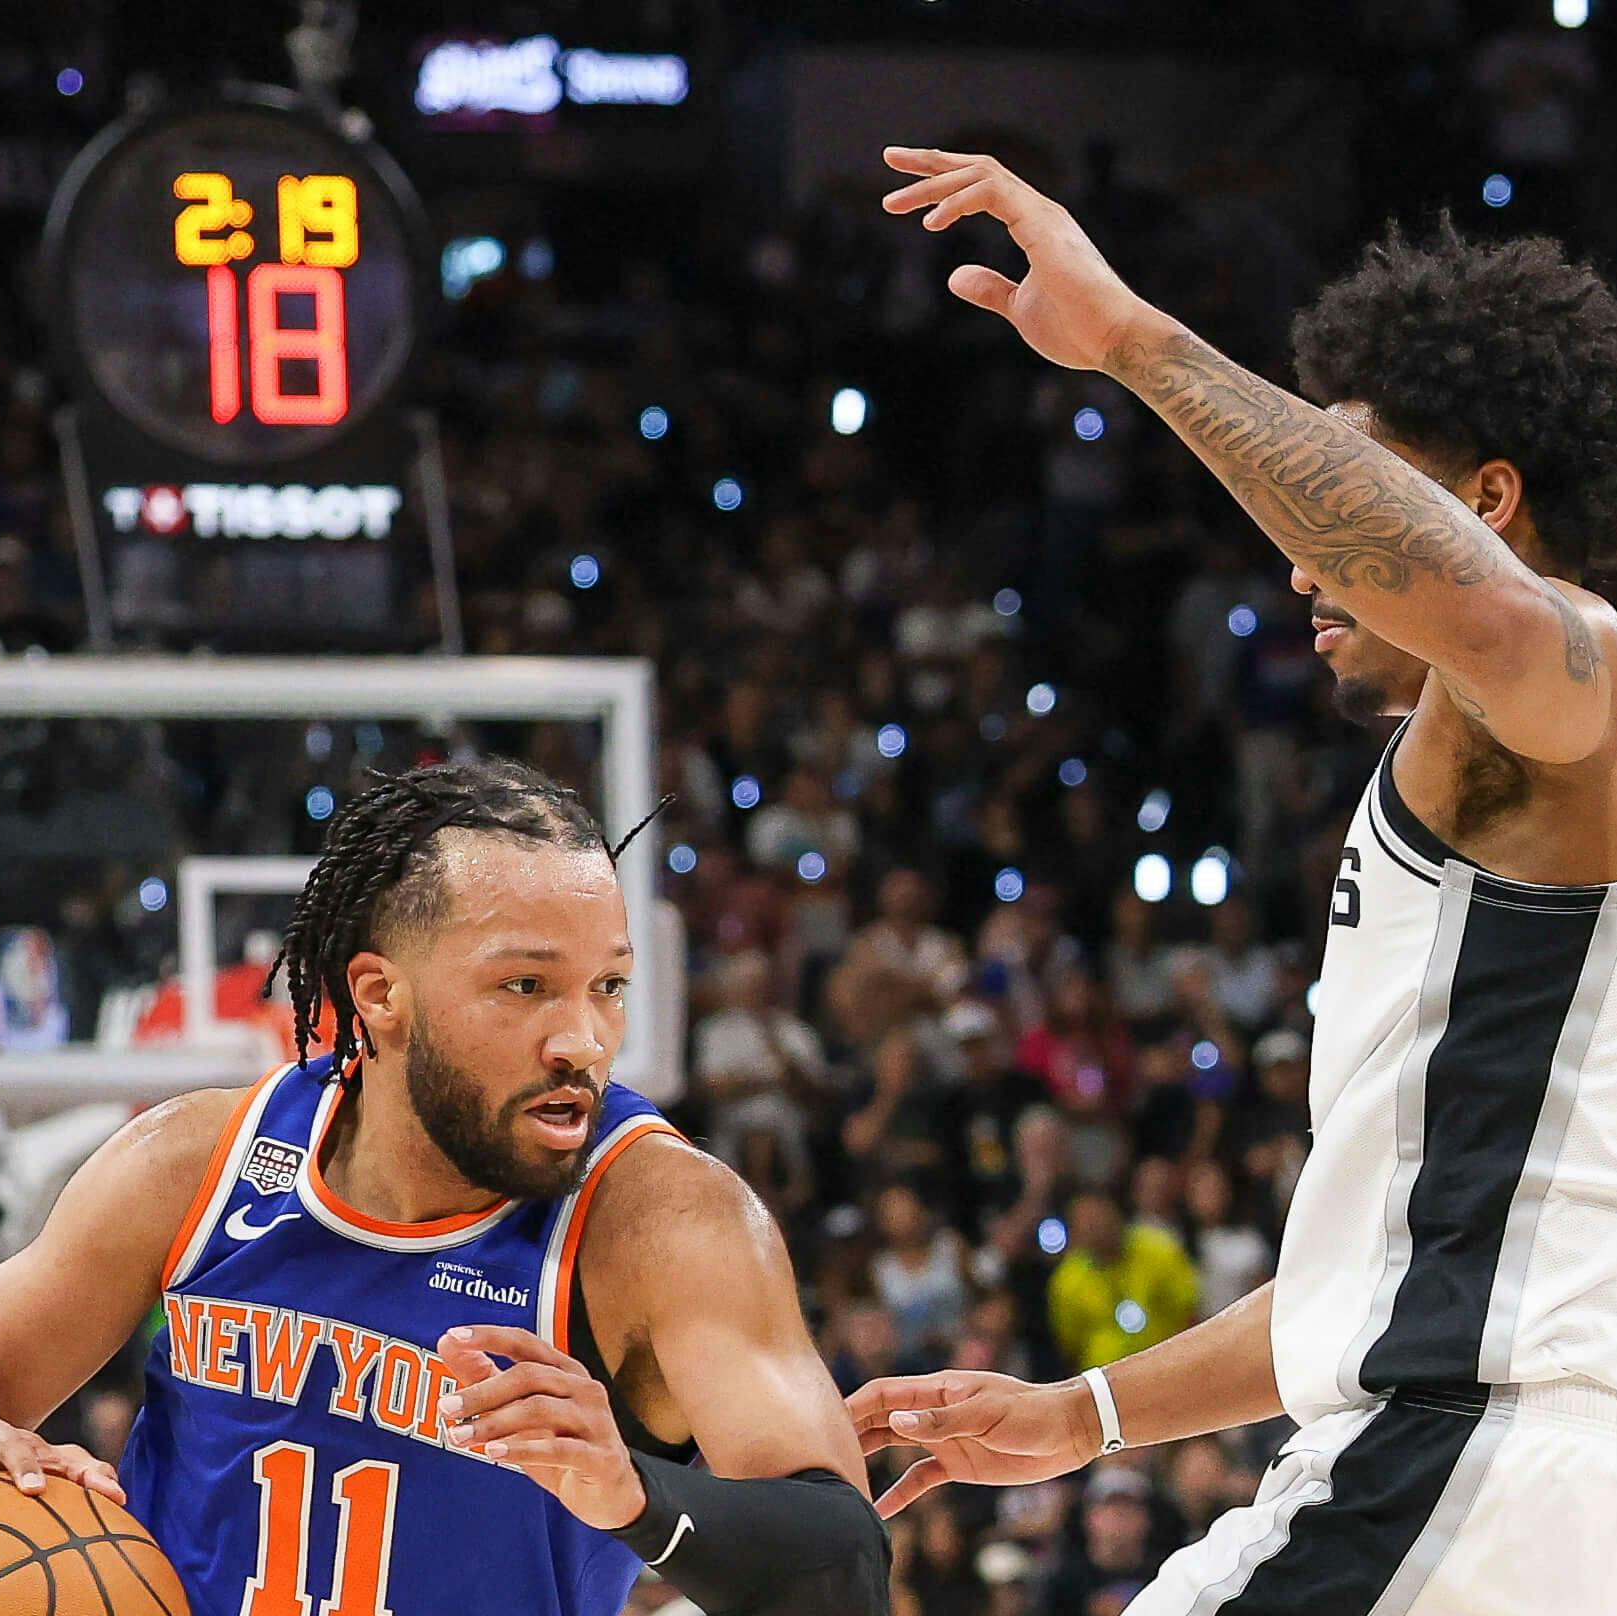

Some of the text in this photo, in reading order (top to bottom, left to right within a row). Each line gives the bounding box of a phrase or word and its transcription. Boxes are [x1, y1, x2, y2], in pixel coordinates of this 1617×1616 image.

[173, 172, 360, 268] 2:19
[207, 263, 350, 426] 18
[183, 483, 403, 540] TISSOT
[245, 1162, 295, 1188] 250
[256, 1144, 298, 1167] USA
[428, 1271, 531, 1307] abu dhabi
[435, 1261, 484, 1277] experience
[163, 1292, 522, 1474] NEW YOR
